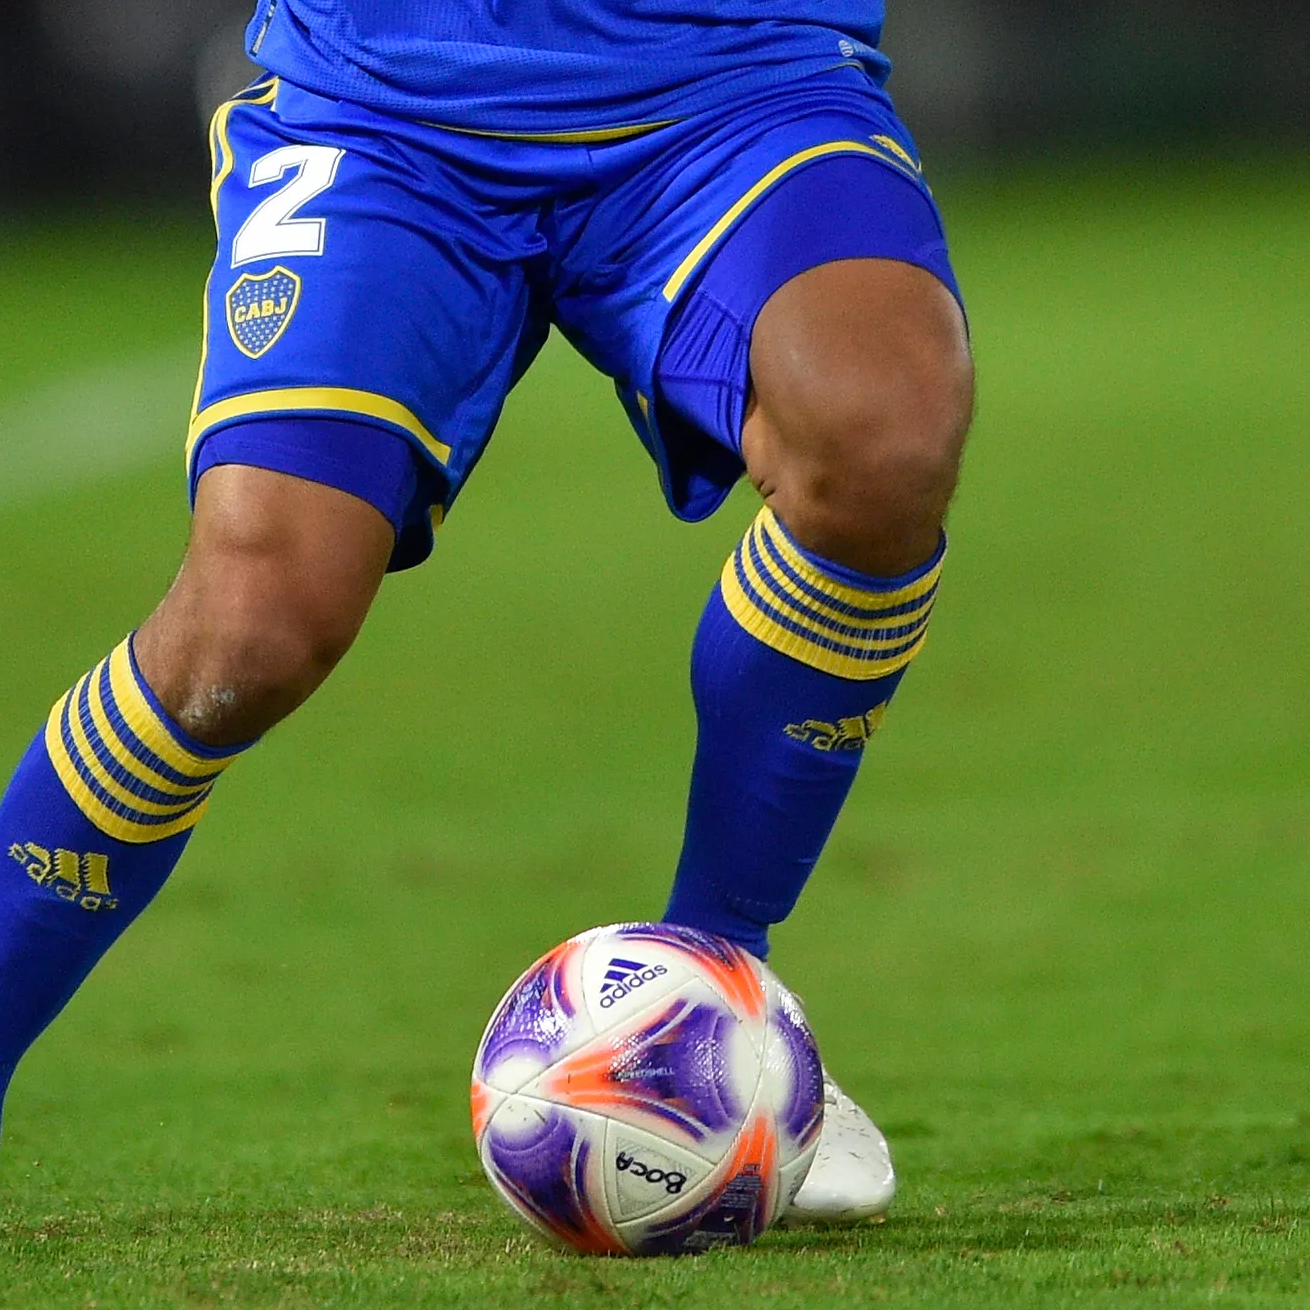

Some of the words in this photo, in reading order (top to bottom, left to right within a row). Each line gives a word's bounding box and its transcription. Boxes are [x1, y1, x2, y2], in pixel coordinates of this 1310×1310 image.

[230, 144, 346, 269] 2
[234, 296, 288, 323] CABJ
[7, 842, 119, 911] adidas
[600, 964, 668, 1008] adidas
[616, 1151, 687, 1194] BOCA
